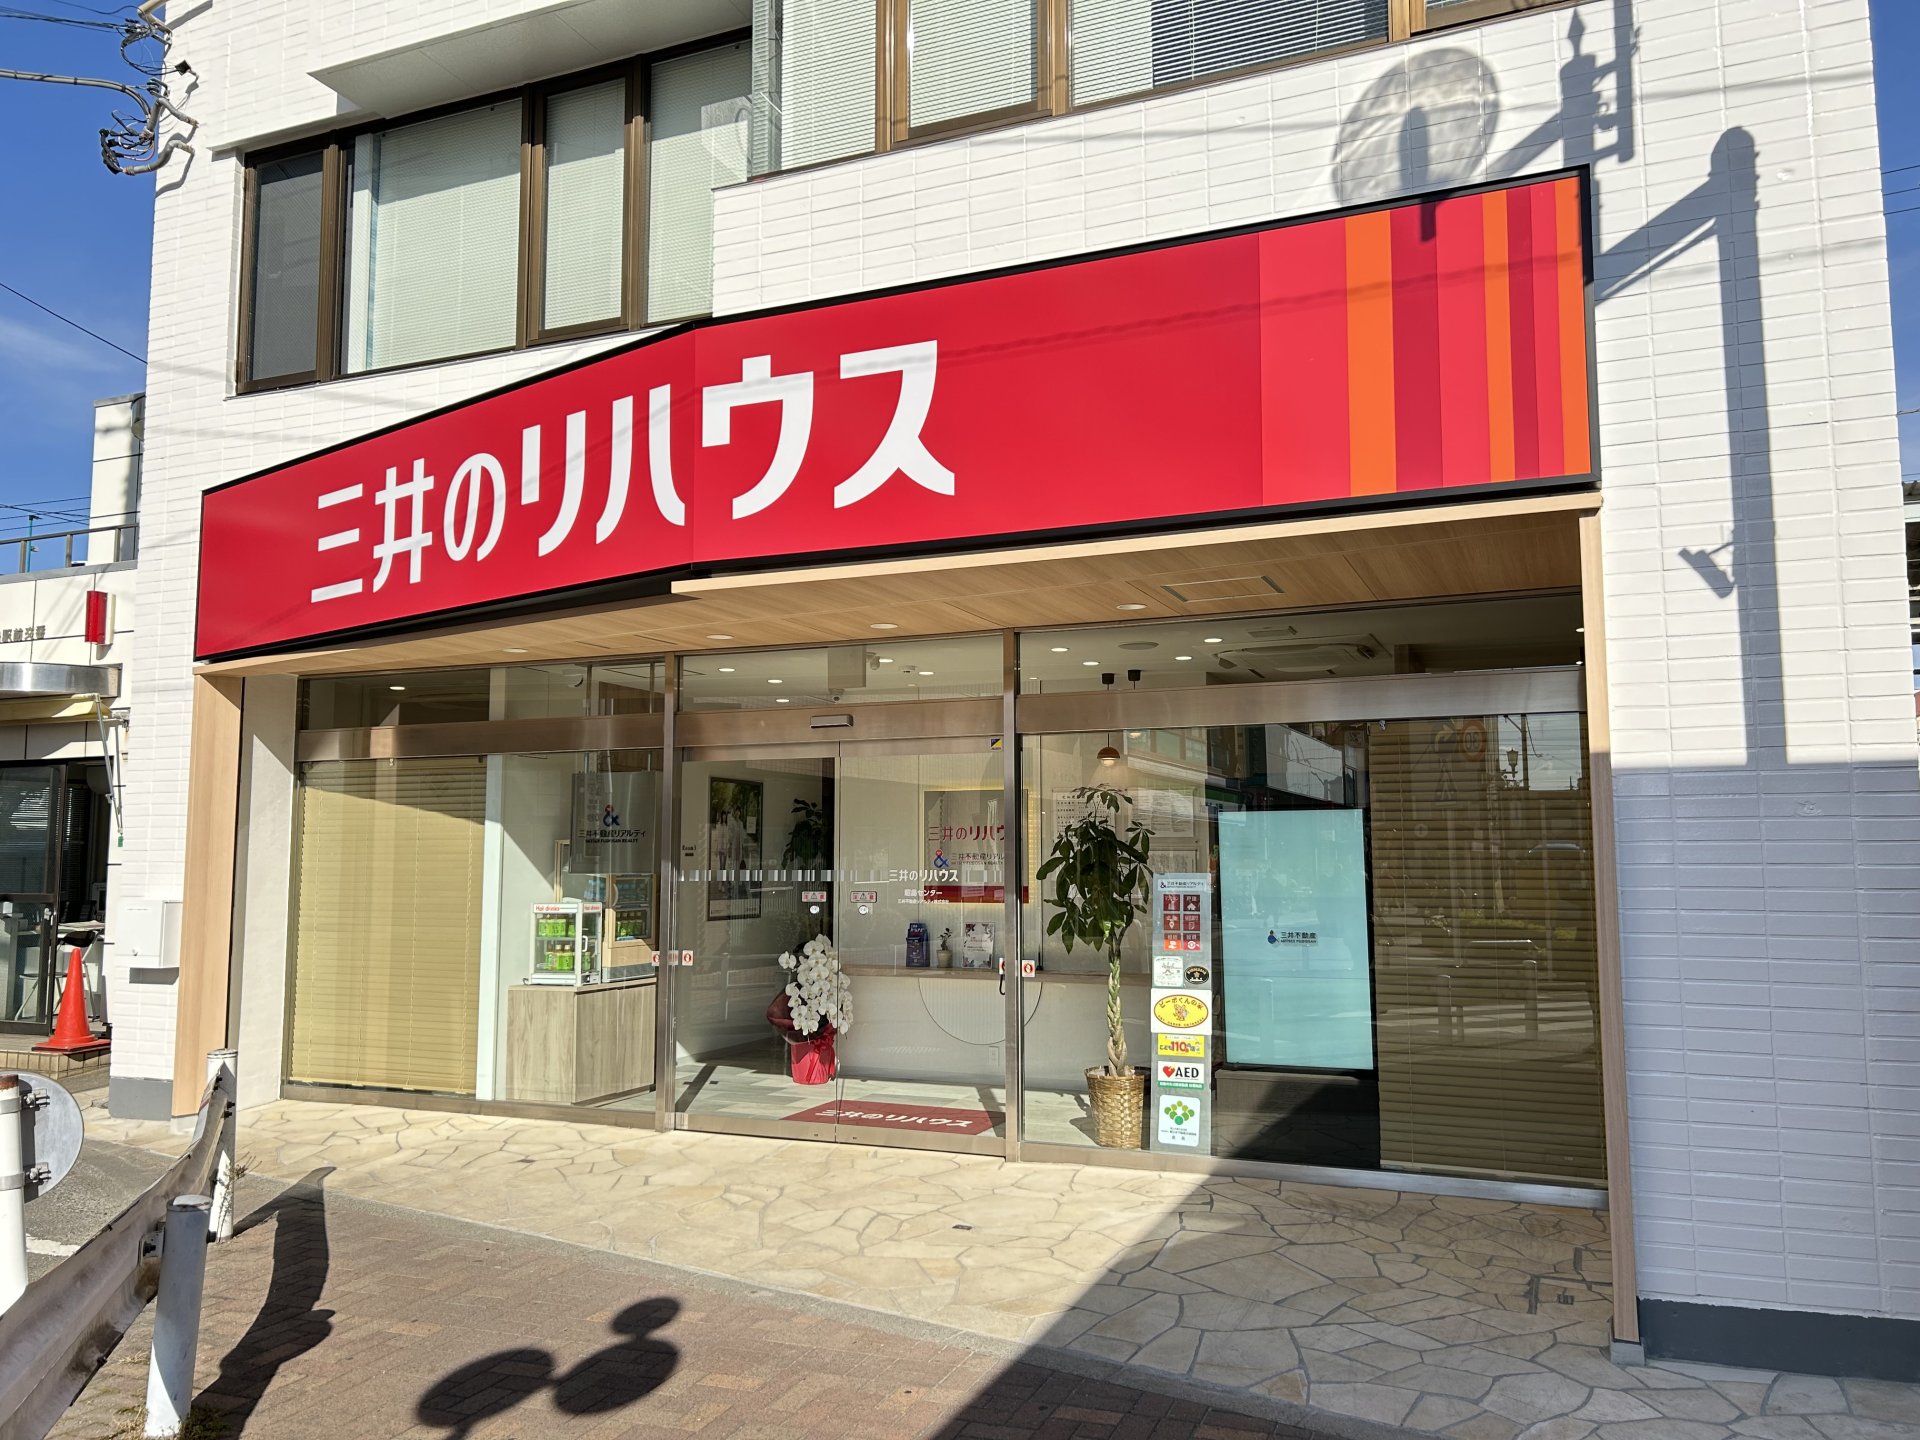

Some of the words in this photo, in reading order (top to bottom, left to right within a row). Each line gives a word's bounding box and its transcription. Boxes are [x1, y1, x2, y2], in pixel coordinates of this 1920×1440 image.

[312, 340, 955, 602] 三井のリハウス
[0, 625, 45, 642] 駅前交番
[889, 869, 959, 882] 三井のリハウス
[1280, 931, 1317, 939] 三井不動産
[1174, 1066, 1199, 1079] AED
[815, 1109, 973, 1128] 三井のリハウス
